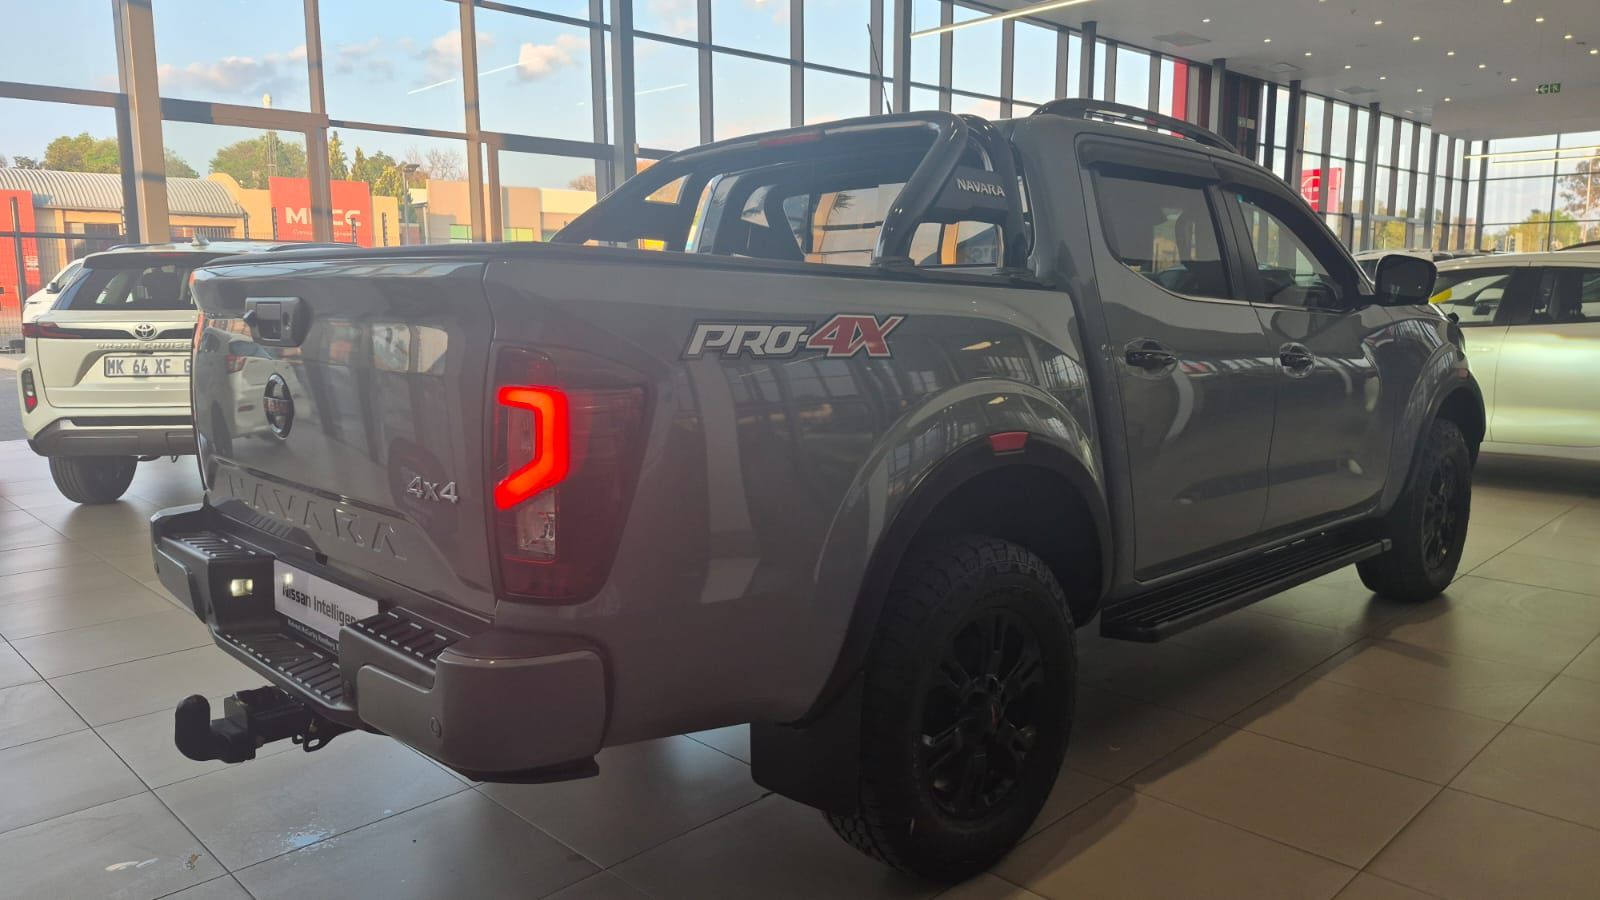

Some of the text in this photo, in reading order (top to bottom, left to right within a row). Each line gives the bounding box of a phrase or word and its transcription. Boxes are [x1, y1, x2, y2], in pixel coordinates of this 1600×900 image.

[957, 178, 1006, 197] NAVARA
[96, 341, 141, 350] URBAN
[685, 313, 906, 358] PRO-4X
[107, 359, 124, 374] MK
[133, 359, 148, 374] 64
[155, 359, 172, 374] XF
[406, 476, 459, 504] 4x4
[227, 472, 409, 561] NAVARA
[282, 583, 360, 627] Nissan Intelligen
